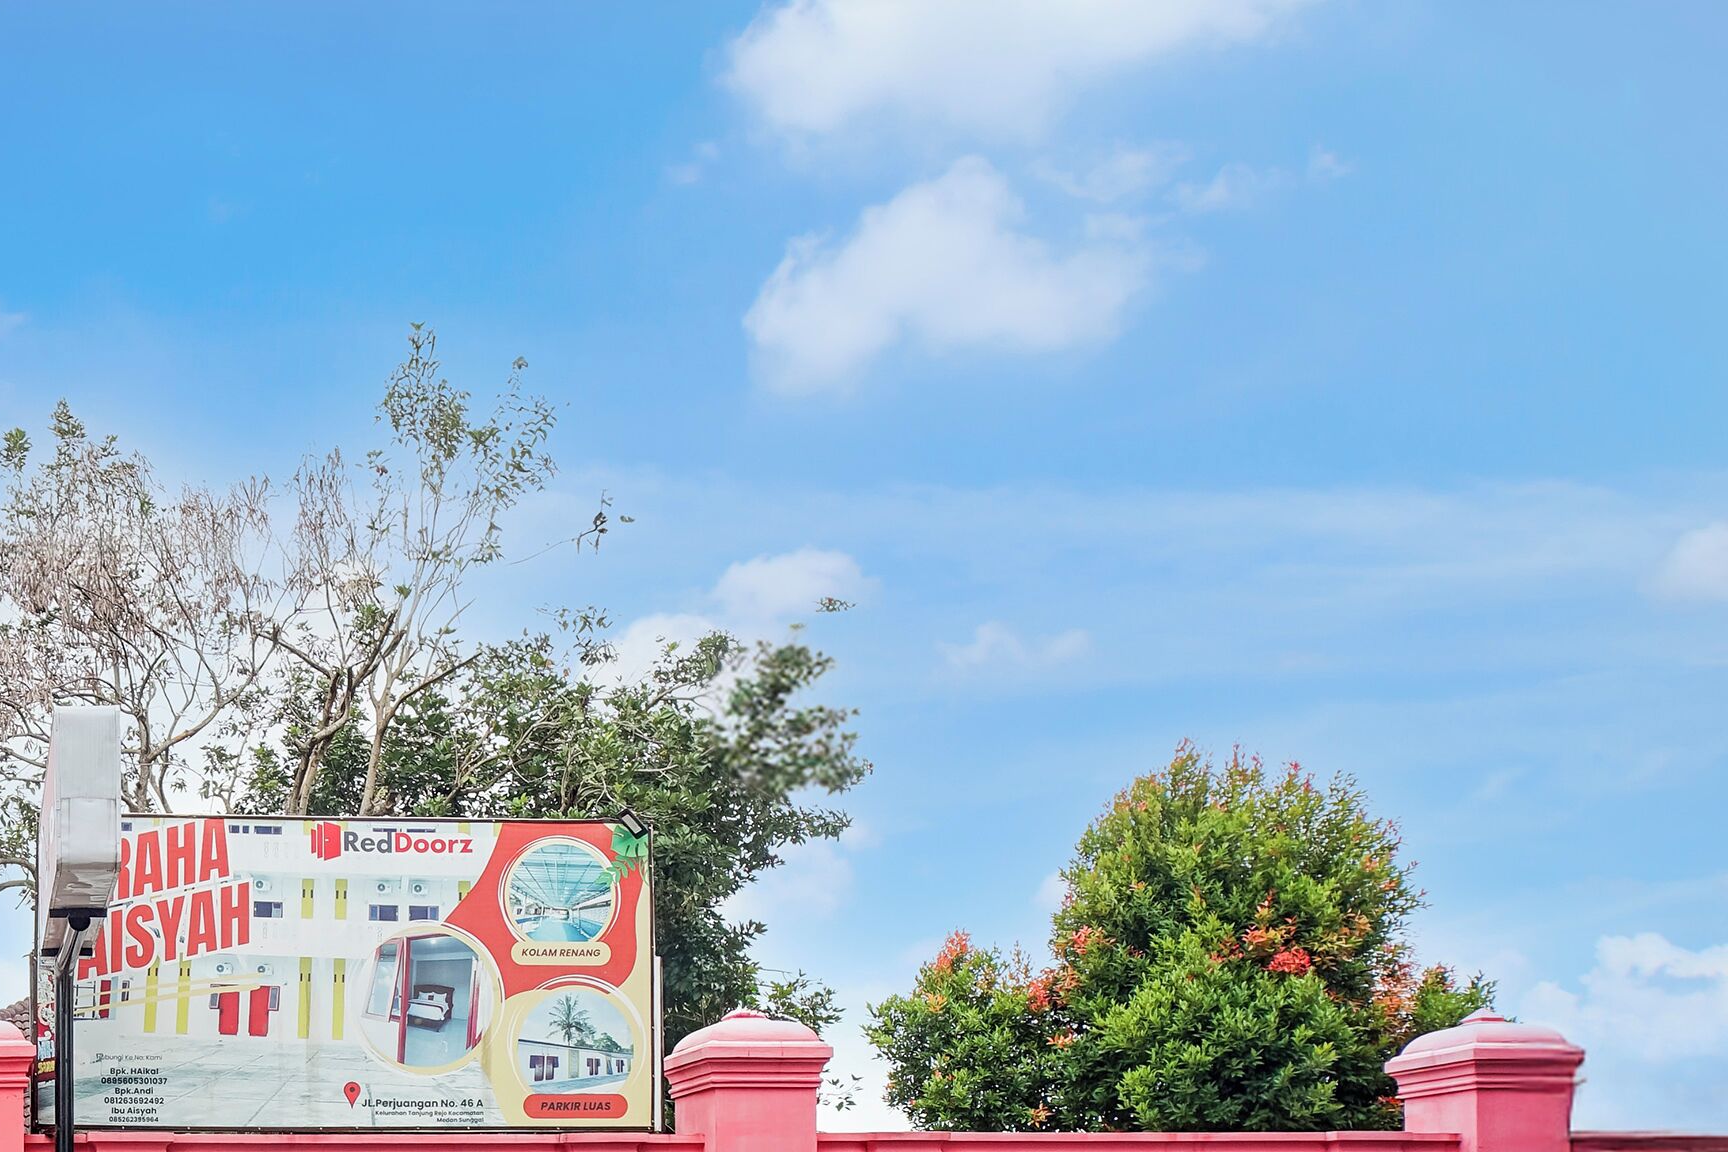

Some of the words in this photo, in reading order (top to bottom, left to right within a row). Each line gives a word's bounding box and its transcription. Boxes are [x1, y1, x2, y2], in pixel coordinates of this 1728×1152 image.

[344, 830, 473, 853] RedDoorz
[77, 882, 249, 981] AISYAH
[521, 948, 557, 957] KOLAM
[559, 948, 601, 957] RENANG
[110, 1067, 129, 1076] Bpk.
[130, 1067, 159, 1075] HAikal
[114, 1087, 154, 1096] Bpk.Andi
[440, 1099, 458, 1108] No.
[461, 1099, 474, 1108] 46
[476, 1099, 484, 1108] A
[540, 1102, 580, 1111] PARKIR
[583, 1102, 611, 1111] LUAS
[127, 1107, 157, 1116] Aisyah
